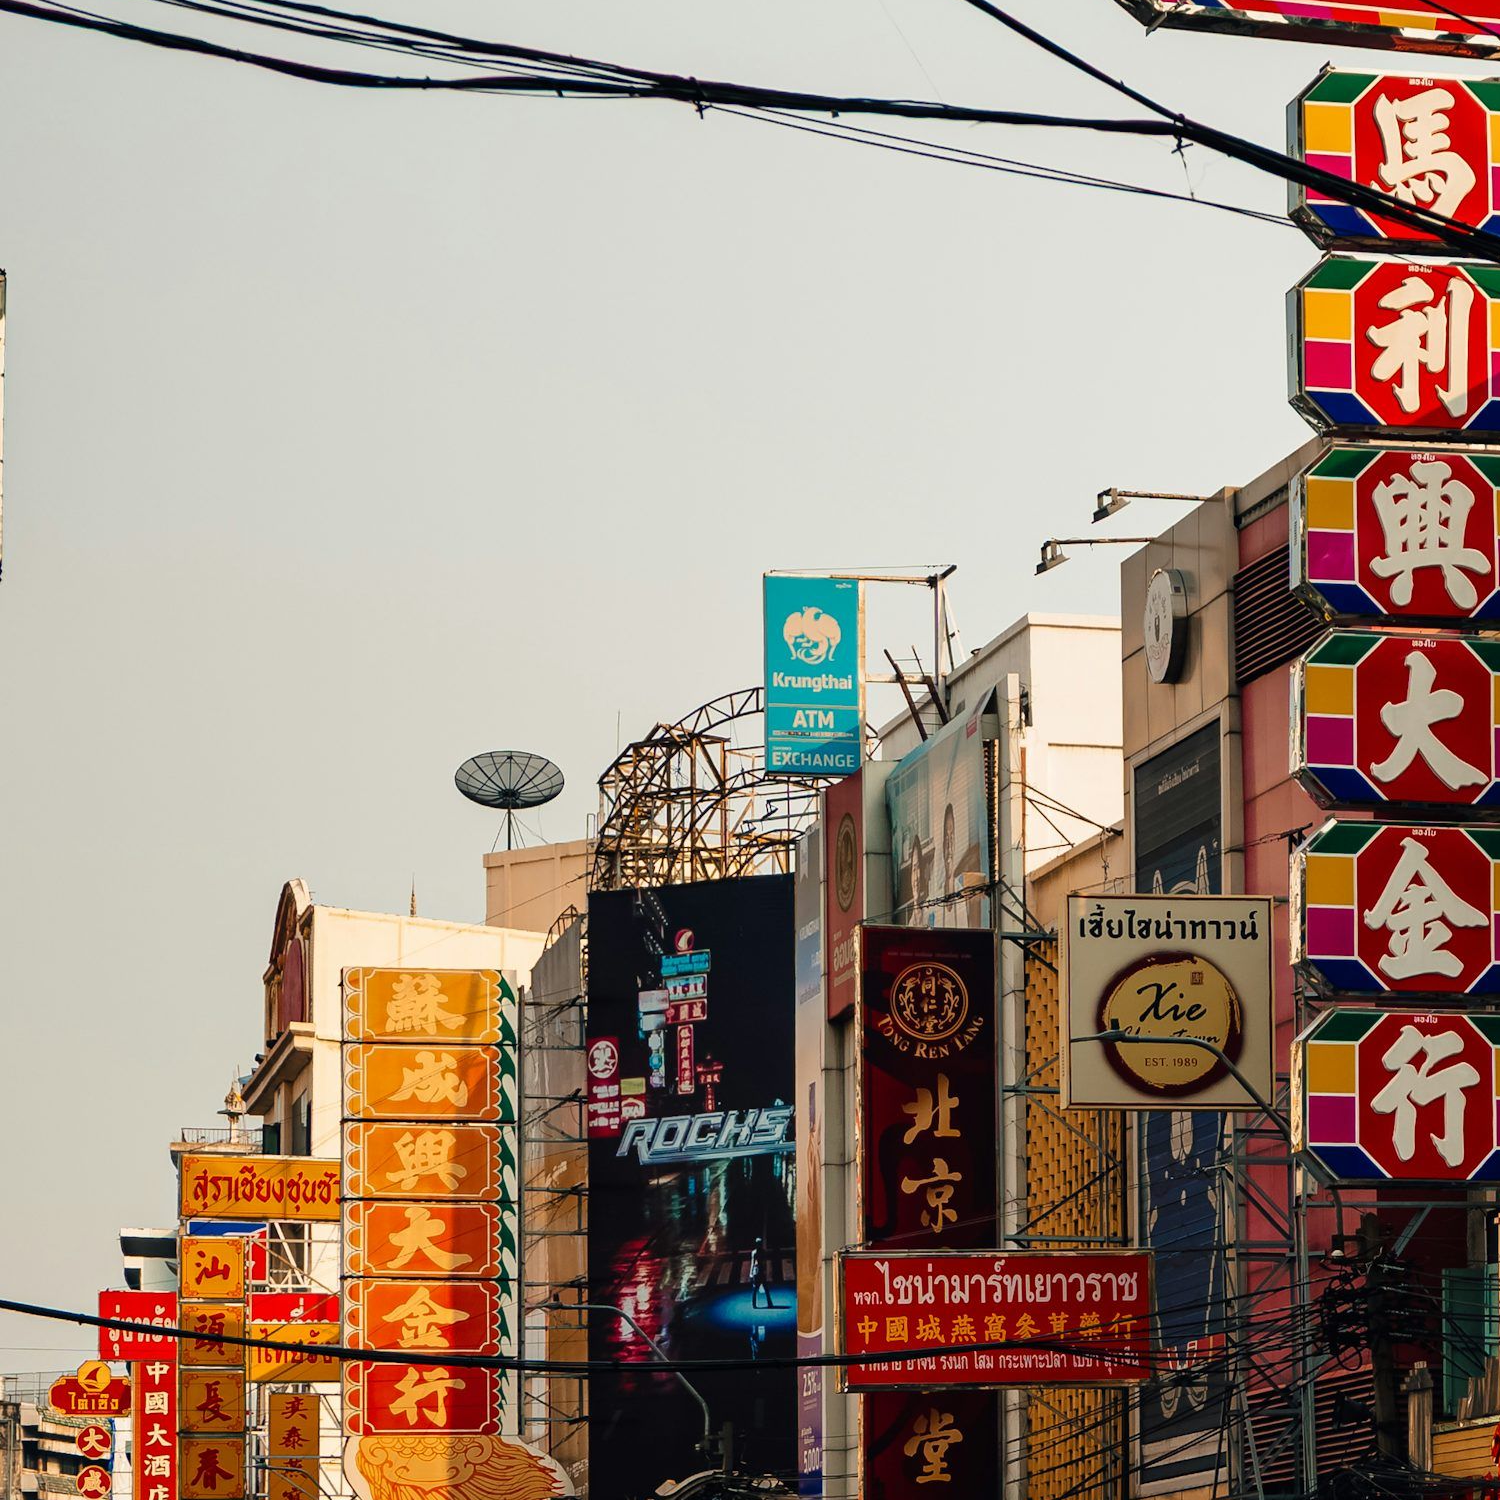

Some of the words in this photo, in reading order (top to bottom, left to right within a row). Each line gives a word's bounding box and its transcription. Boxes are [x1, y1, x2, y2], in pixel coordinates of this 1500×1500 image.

[773, 671, 852, 693] Krungthai
[792, 709, 835, 730] ATM
[772, 750, 855, 768] EXCHANGE
[1137, 982, 1207, 1023] Xie
[1145, 1057, 1169, 1067] EST.
[1173, 1057, 1199, 1067] 1989
[901, 1073, 963, 1241] 北京
[381, 973, 473, 1429] 蘇成興大金行
[854, 1289, 883, 1307] หจก.
[875, 1259, 1139, 1305] ไชน่ามาร์ทเยาวราช
[998, 1350, 1068, 1370] กระเพาะปลา
[903, 1406, 964, 1485] 堂
